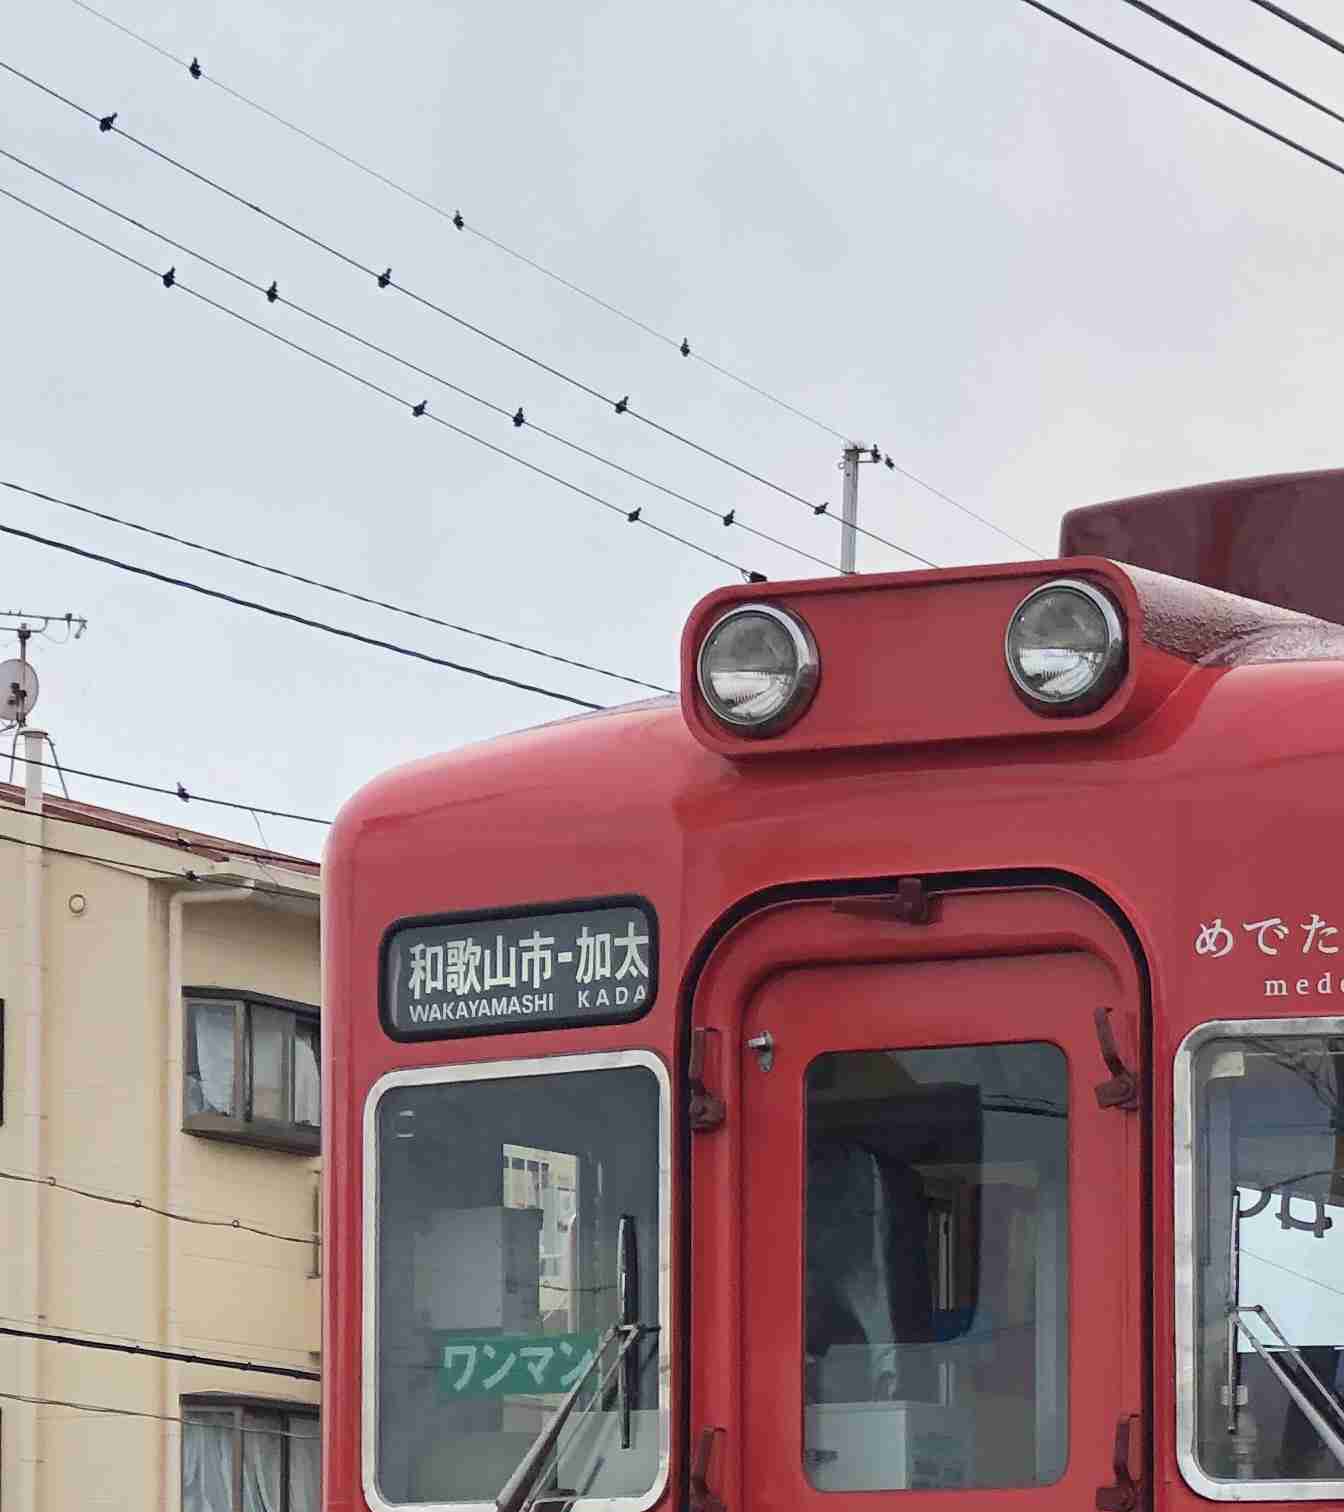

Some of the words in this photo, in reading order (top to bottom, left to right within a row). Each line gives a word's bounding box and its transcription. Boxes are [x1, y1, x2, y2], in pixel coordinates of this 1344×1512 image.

[409, 993, 554, 1023] WAKAYAMASHI
[577, 984, 647, 1009] KADA
[444, 1341, 595, 1391] ワンマン
